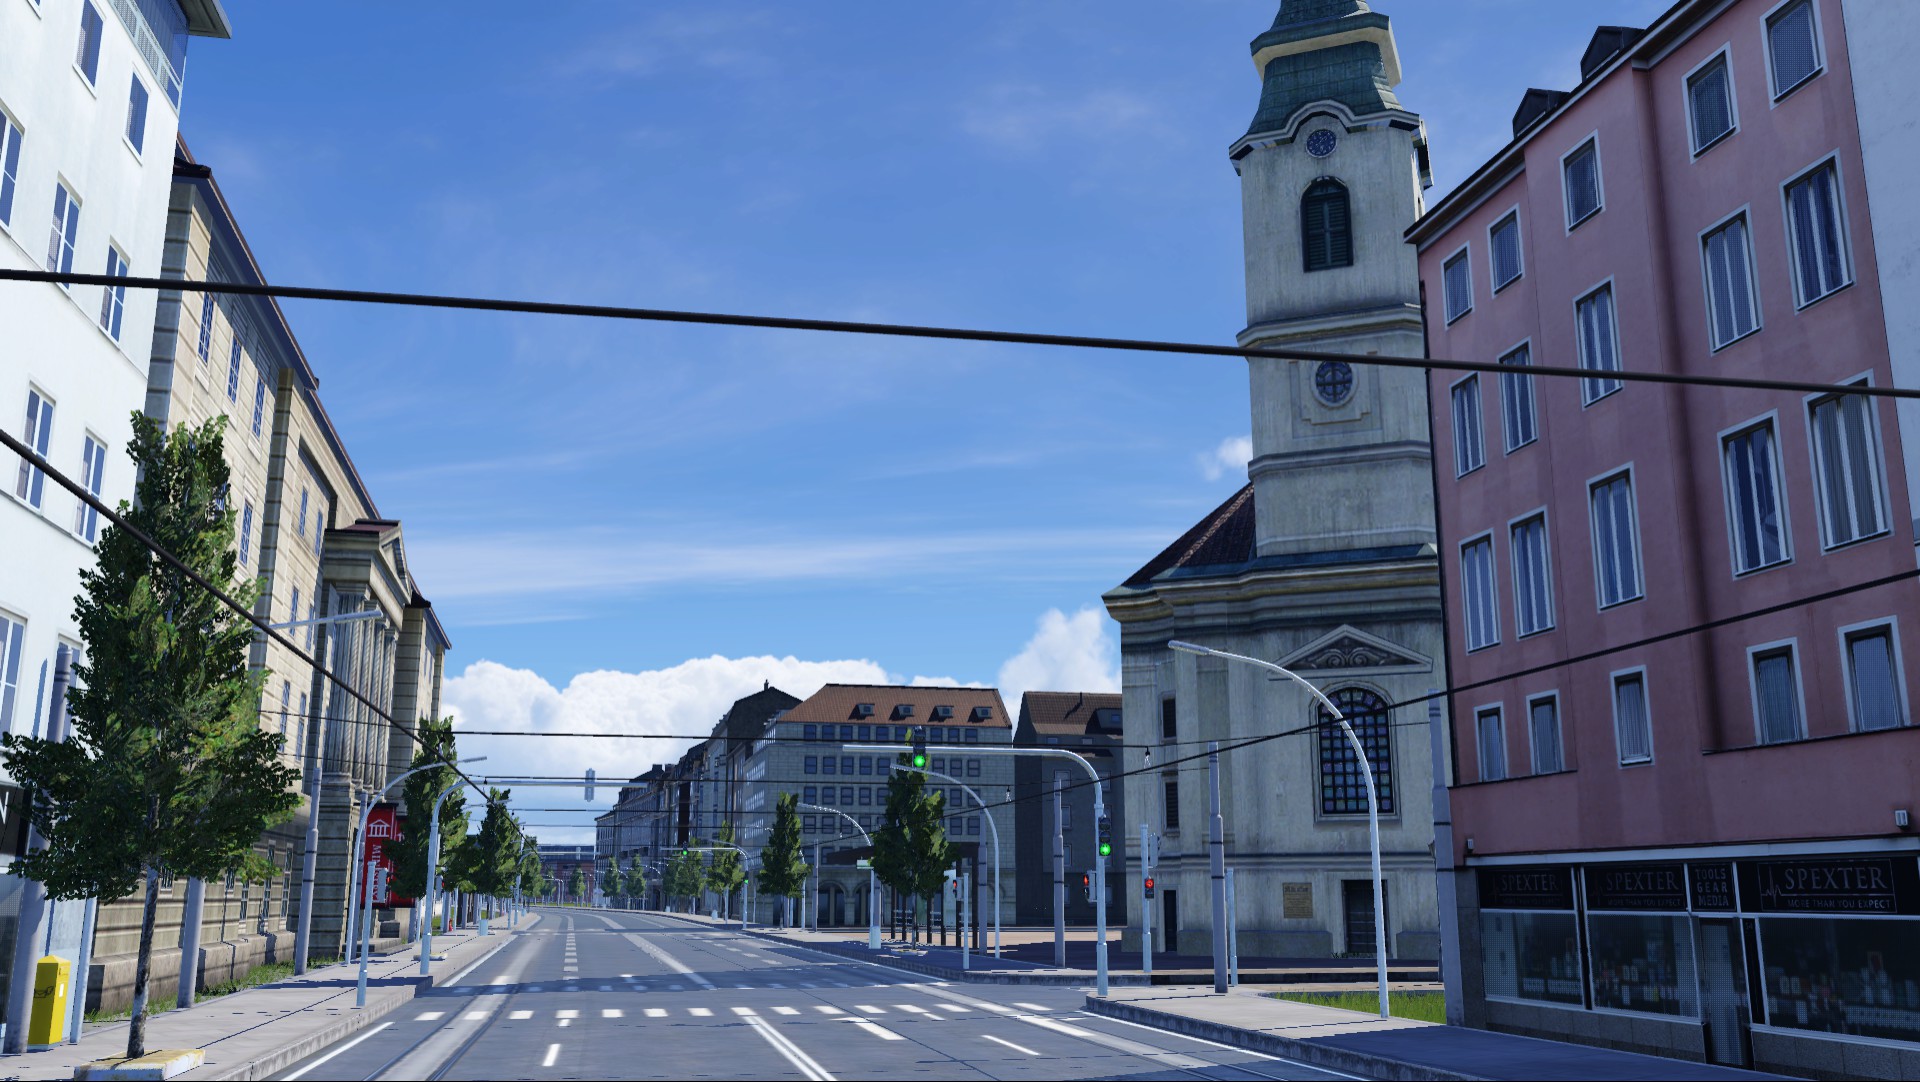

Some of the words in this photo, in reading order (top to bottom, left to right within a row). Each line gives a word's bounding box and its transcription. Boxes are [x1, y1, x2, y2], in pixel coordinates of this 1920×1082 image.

[1695, 868, 1726, 880] TOOLS
[1784, 867, 1888, 889] SPEXTER
[1502, 873, 1559, 891] SPEXTER
[1606, 871, 1679, 891] SPEXTER
[1696, 881, 1728, 893] GEAR
[1698, 894, 1729, 907] MEDIA
[1787, 899, 1809, 908] MORE
[1812, 899, 1835, 908] THAN
[1837, 899, 1855, 908] YOU
[1858, 899, 1891, 909] EXPECT
